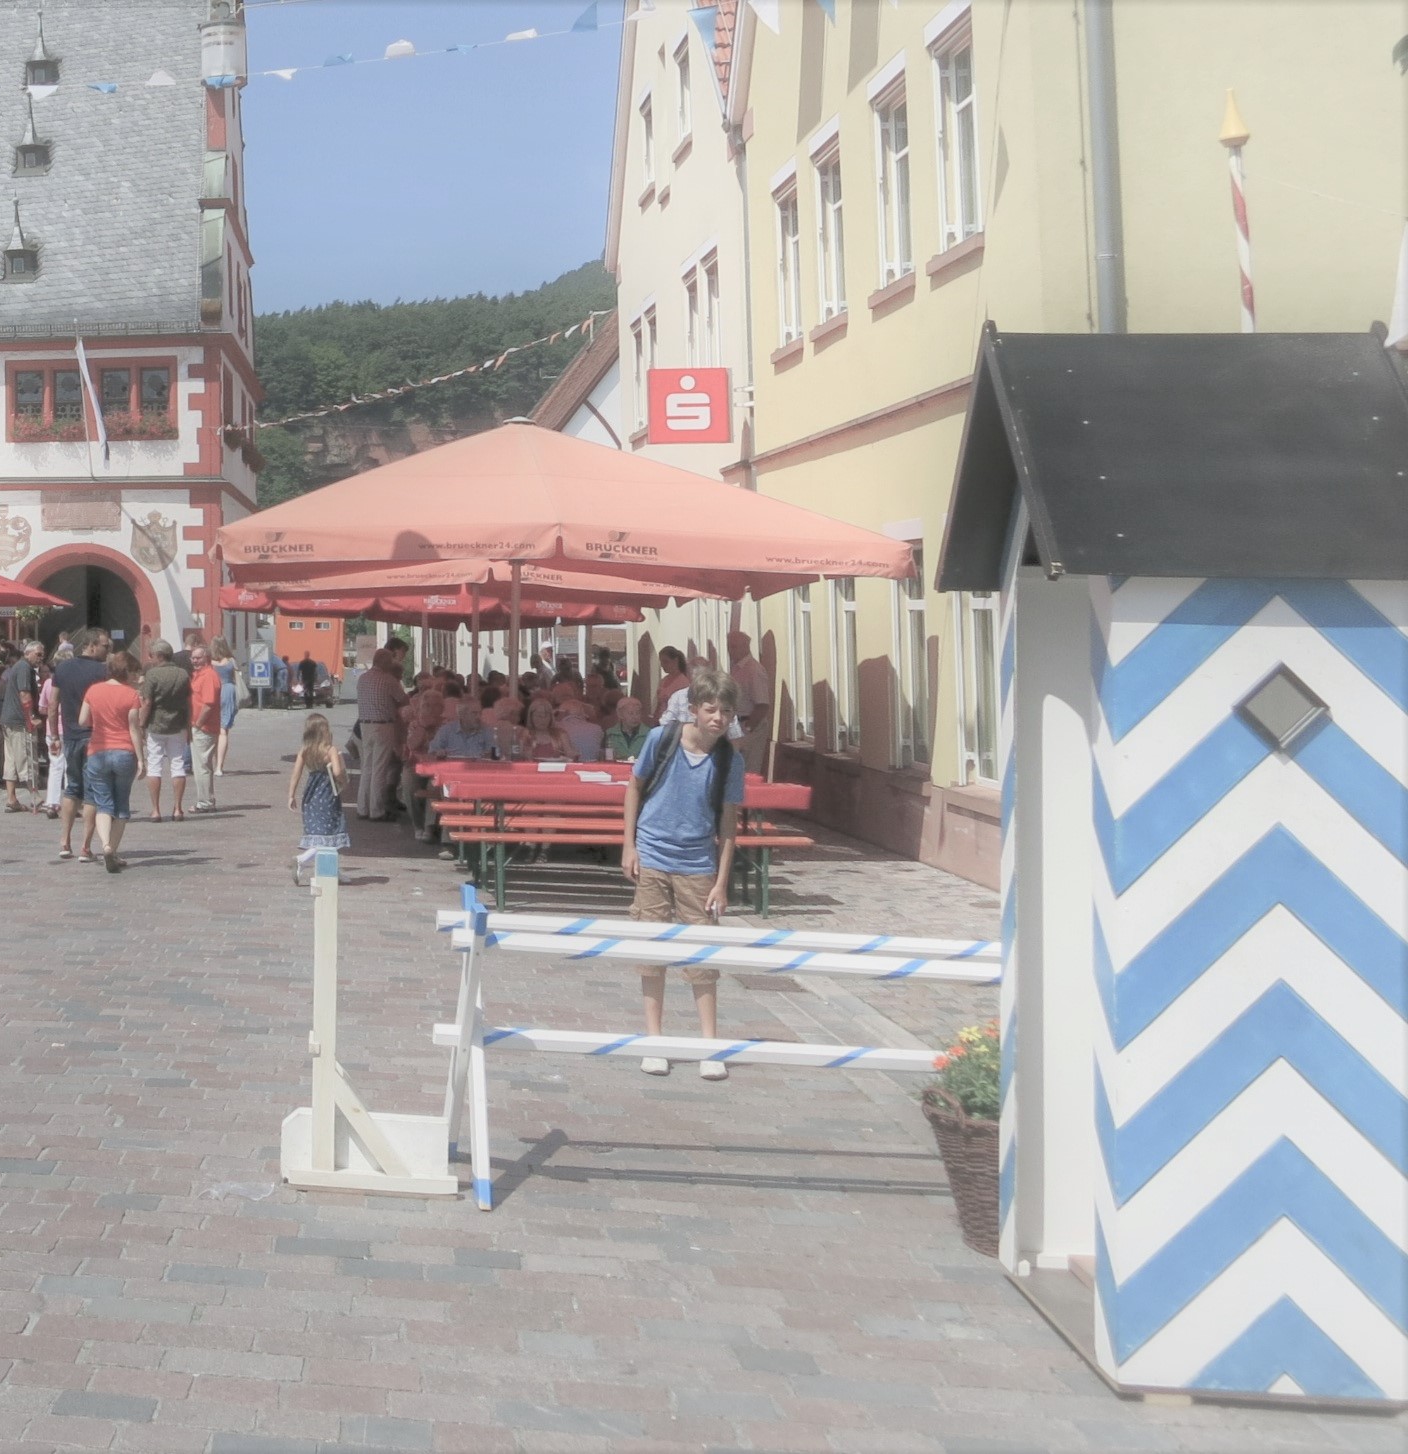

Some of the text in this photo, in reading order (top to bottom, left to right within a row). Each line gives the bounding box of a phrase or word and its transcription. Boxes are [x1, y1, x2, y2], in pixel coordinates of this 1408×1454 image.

[418, 541, 535, 550] www.brueckner24.com
[765, 555, 890, 568] www.brueckner24.com
[254, 663, 266, 676] P
